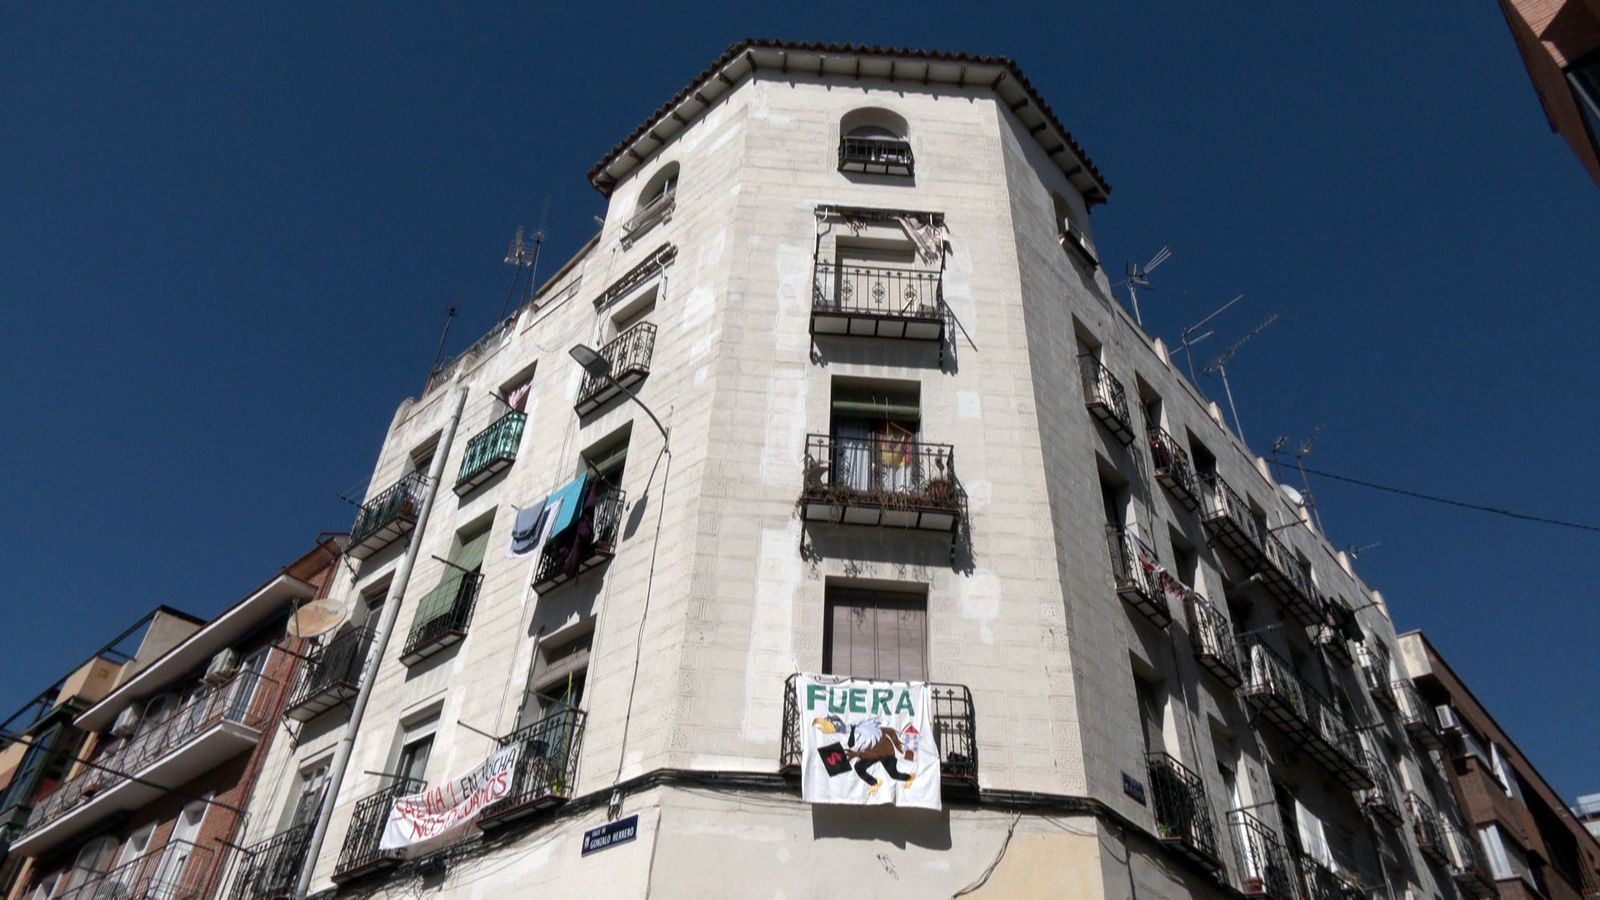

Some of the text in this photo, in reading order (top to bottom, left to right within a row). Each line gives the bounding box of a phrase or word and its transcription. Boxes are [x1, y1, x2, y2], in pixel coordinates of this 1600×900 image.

[806, 684, 915, 716] FUERA
[460, 772, 479, 800] EN
[590, 826, 635, 850] GONZALO HERRERO
